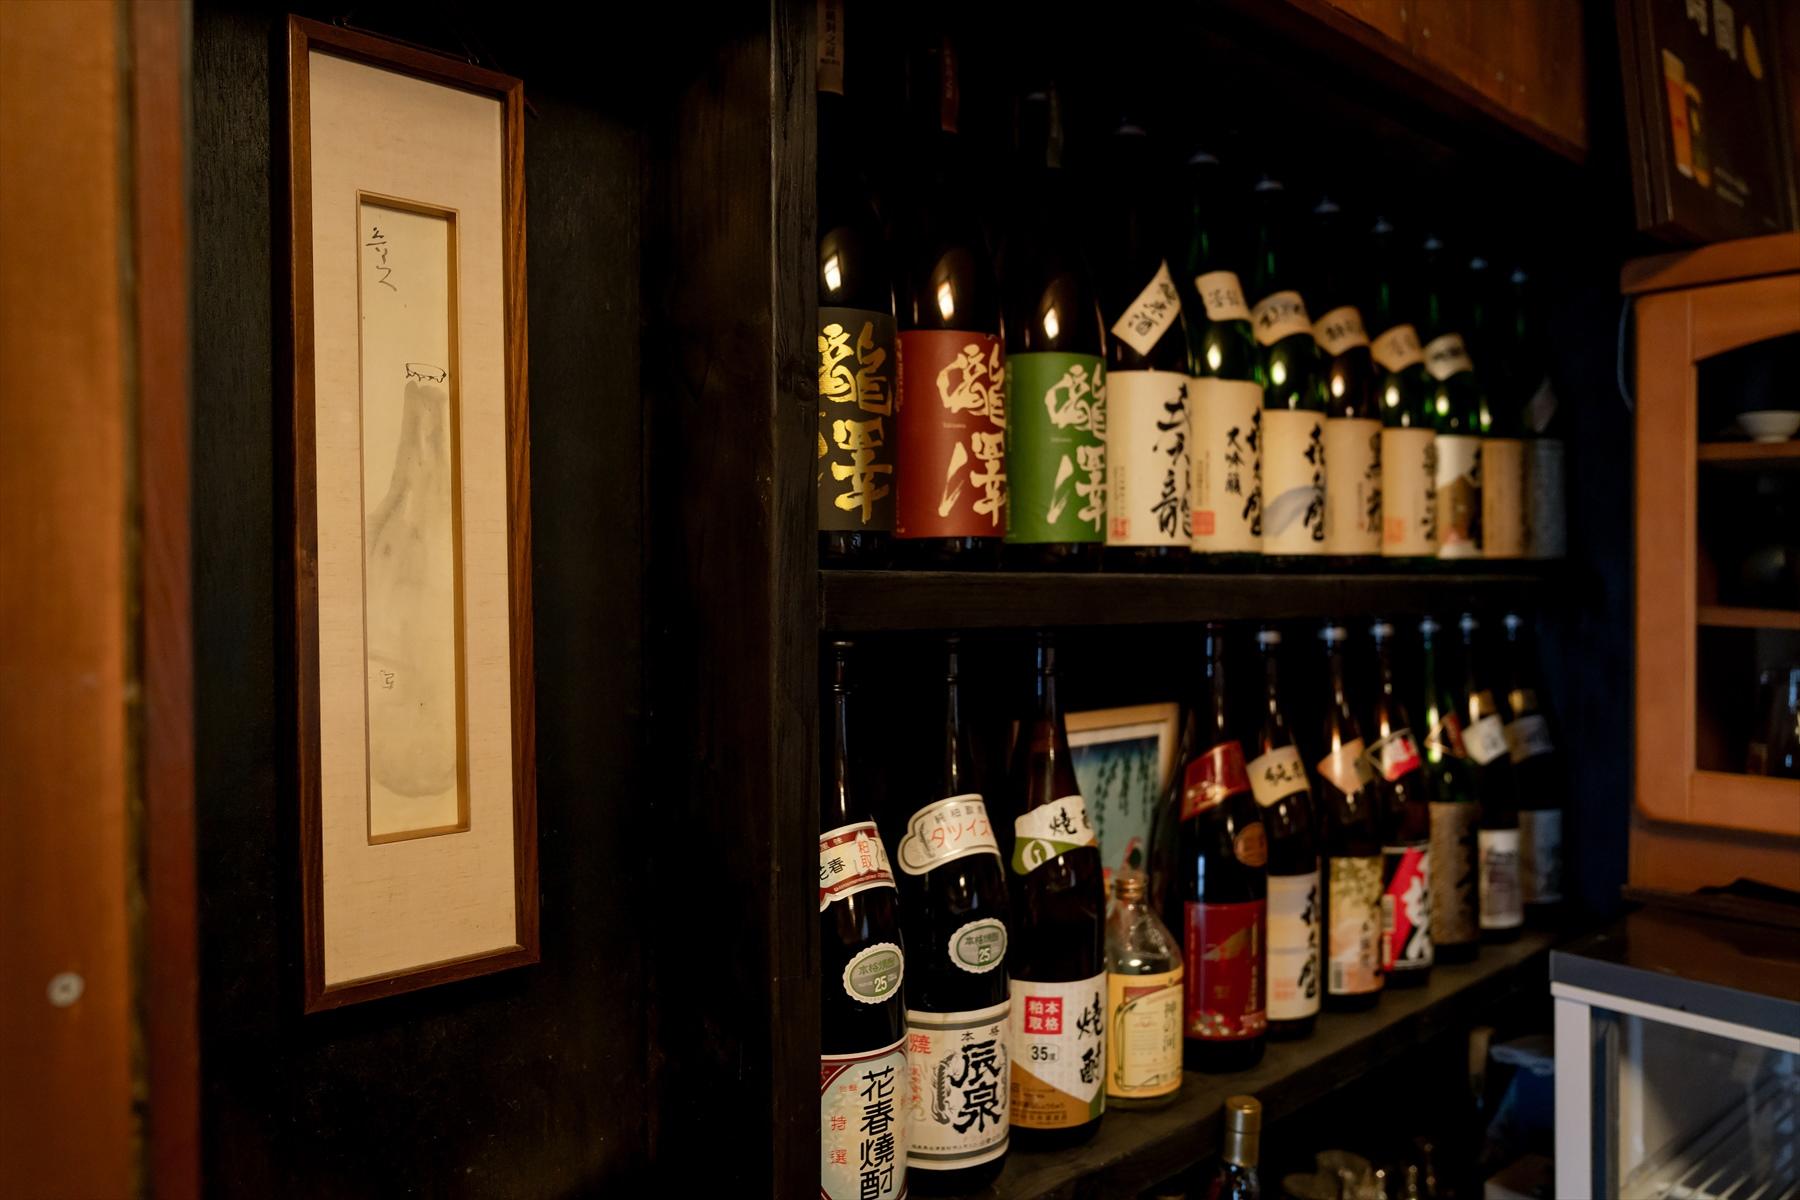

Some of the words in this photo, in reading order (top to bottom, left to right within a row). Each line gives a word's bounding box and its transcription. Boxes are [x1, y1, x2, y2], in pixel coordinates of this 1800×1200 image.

[978, 947, 991, 962] 25
[873, 975, 888, 993] 25
[949, 1039, 1002, 1134] 辰泉
